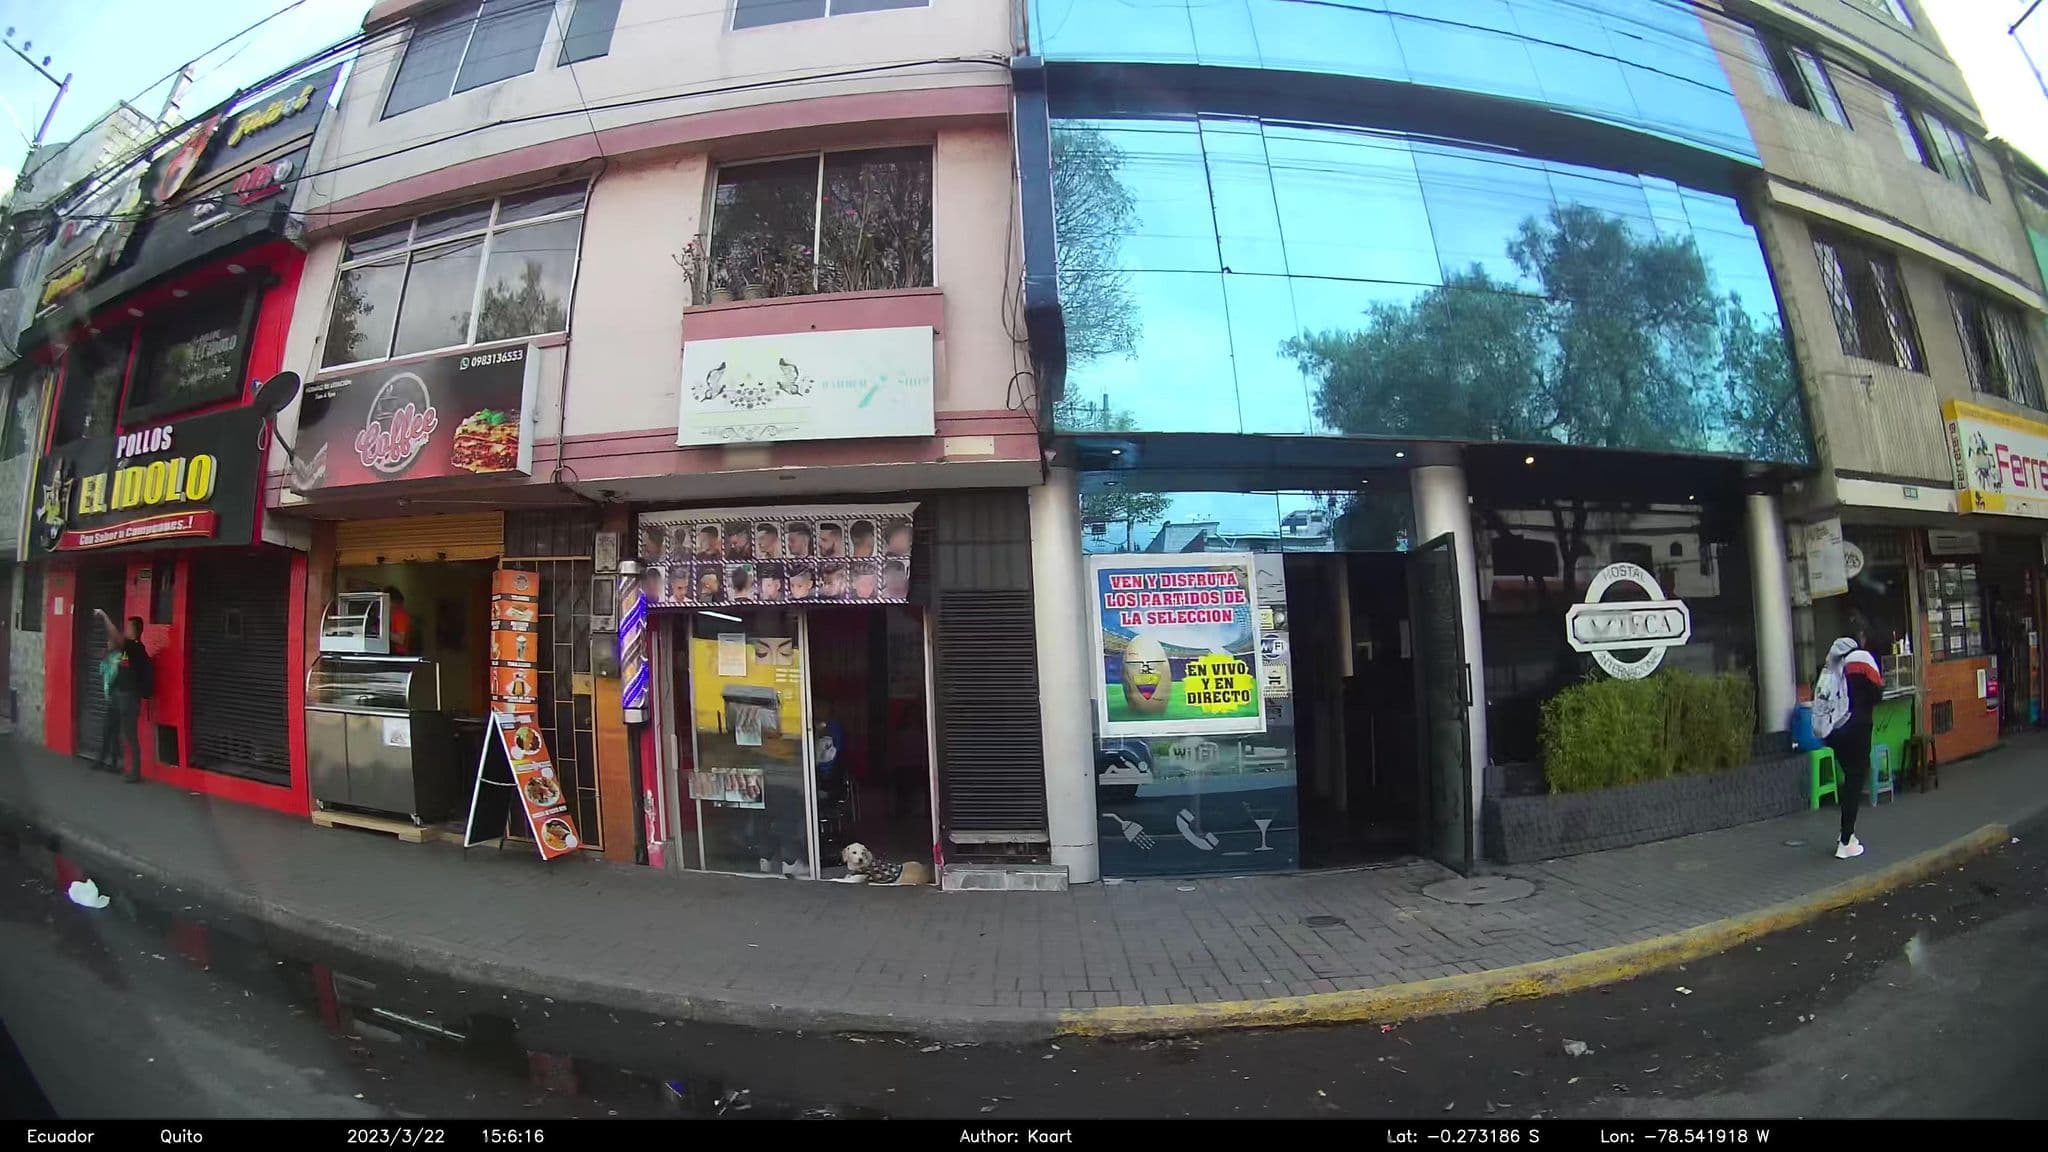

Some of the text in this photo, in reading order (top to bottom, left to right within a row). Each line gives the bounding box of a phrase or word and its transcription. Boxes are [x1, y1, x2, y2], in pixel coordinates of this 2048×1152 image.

[471, 350, 523, 367] 0983136553
[116, 425, 174, 459] POLLOS
[79, 473, 108, 514] EL
[1110, 572, 1238, 589] VEN Y DISFRUTA
[1106, 590, 1245, 607] LOS PARTIDOS DE
[1121, 609, 1233, 625] LA SELECCION
[1187, 662, 1246, 677] EN VIVO
[1201, 677, 1234, 690] Y EN
[1187, 689, 1250, 704] DIRECTO
